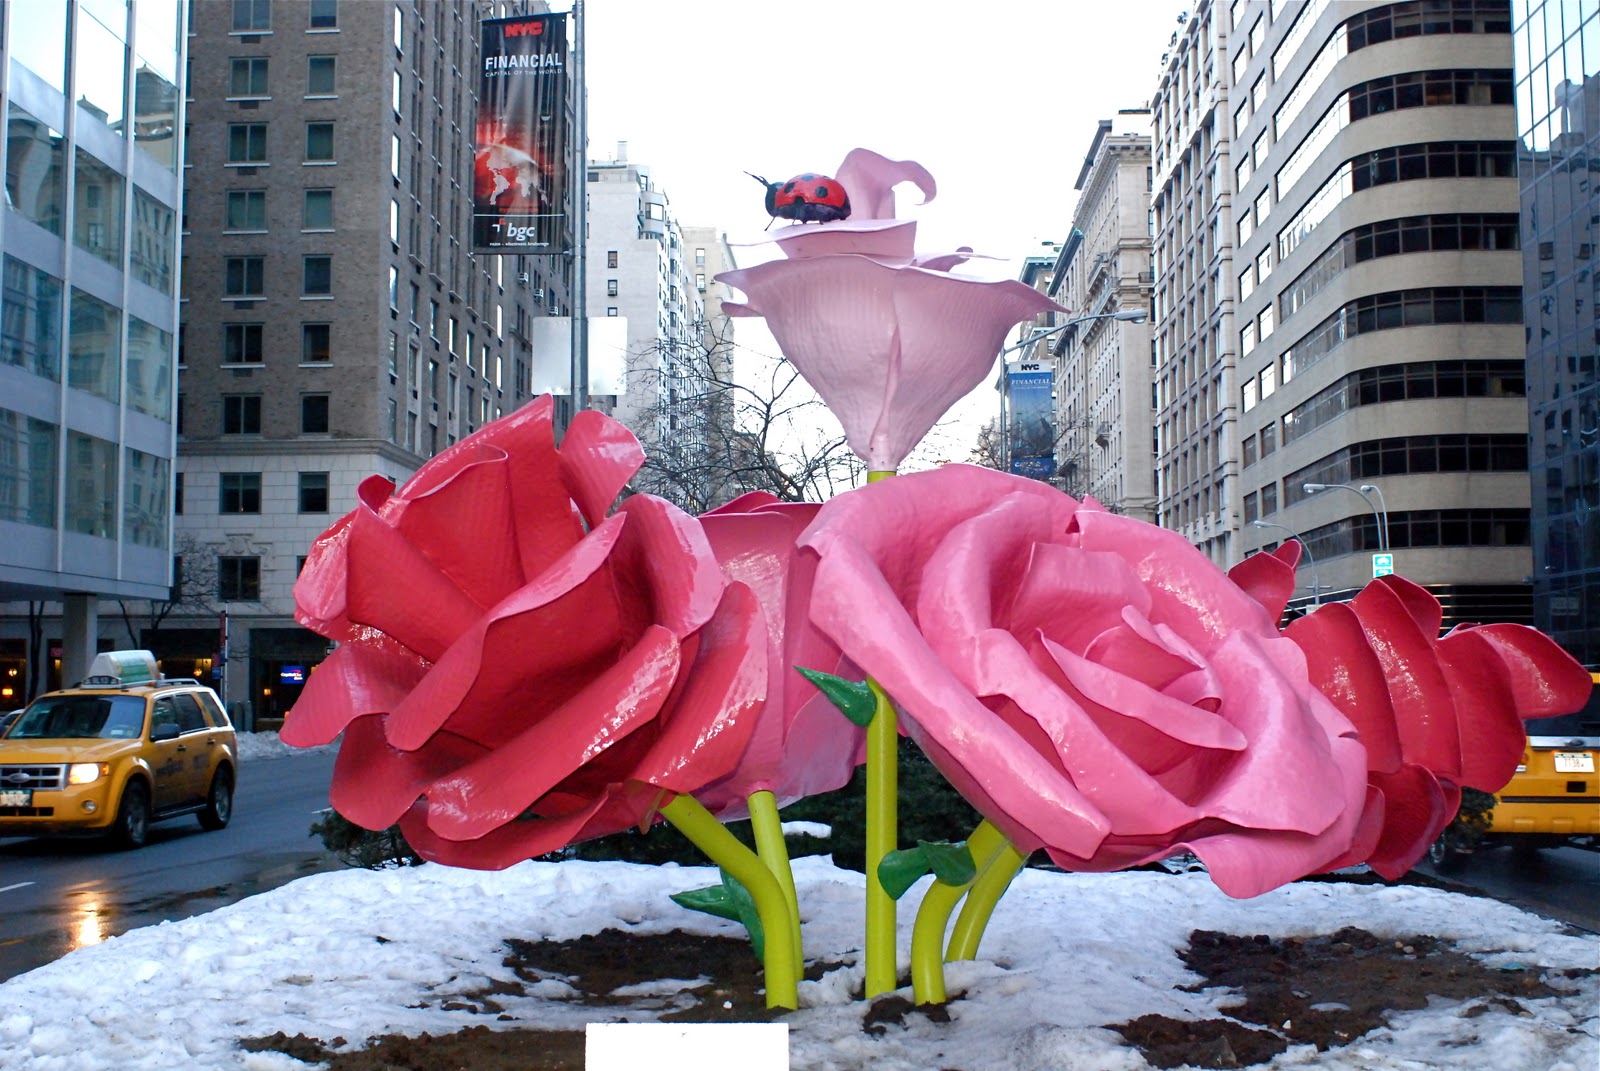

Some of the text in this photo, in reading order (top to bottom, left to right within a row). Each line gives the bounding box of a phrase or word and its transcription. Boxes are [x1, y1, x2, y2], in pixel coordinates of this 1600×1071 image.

[505, 21, 543, 38] NYC
[485, 52, 563, 70] FINANCIAL
[485, 70, 511, 78] CAPITAL
[506, 222, 536, 242] bgc
[1021, 363, 1040, 371] NYC
[1011, 378, 1051, 386] FINANCIAL
